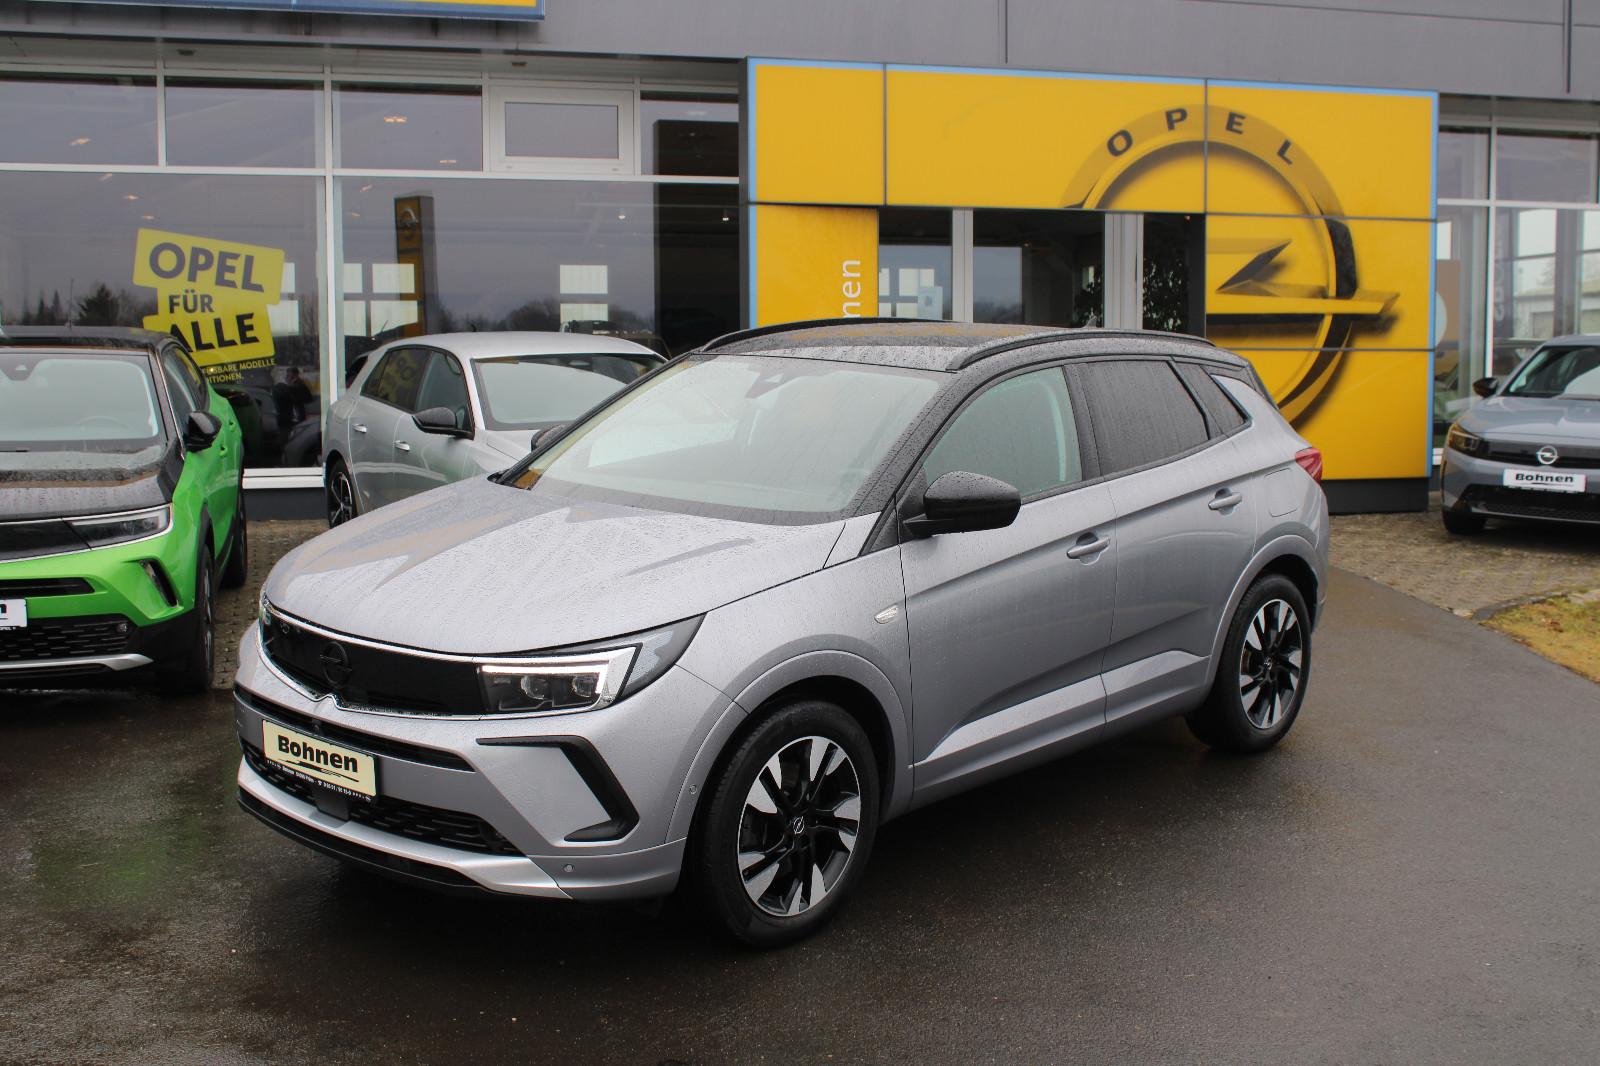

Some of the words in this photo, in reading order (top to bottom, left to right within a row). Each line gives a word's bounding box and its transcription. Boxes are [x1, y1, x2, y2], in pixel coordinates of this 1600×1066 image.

[1106, 108, 1294, 165] OPEL
[149, 242, 265, 293] OPEL
[168, 289, 214, 314] FÜR
[240, 359, 276, 369] MODELLE
[1515, 473, 1574, 483] Bohnen
[277, 734, 359, 774] Bohnen
